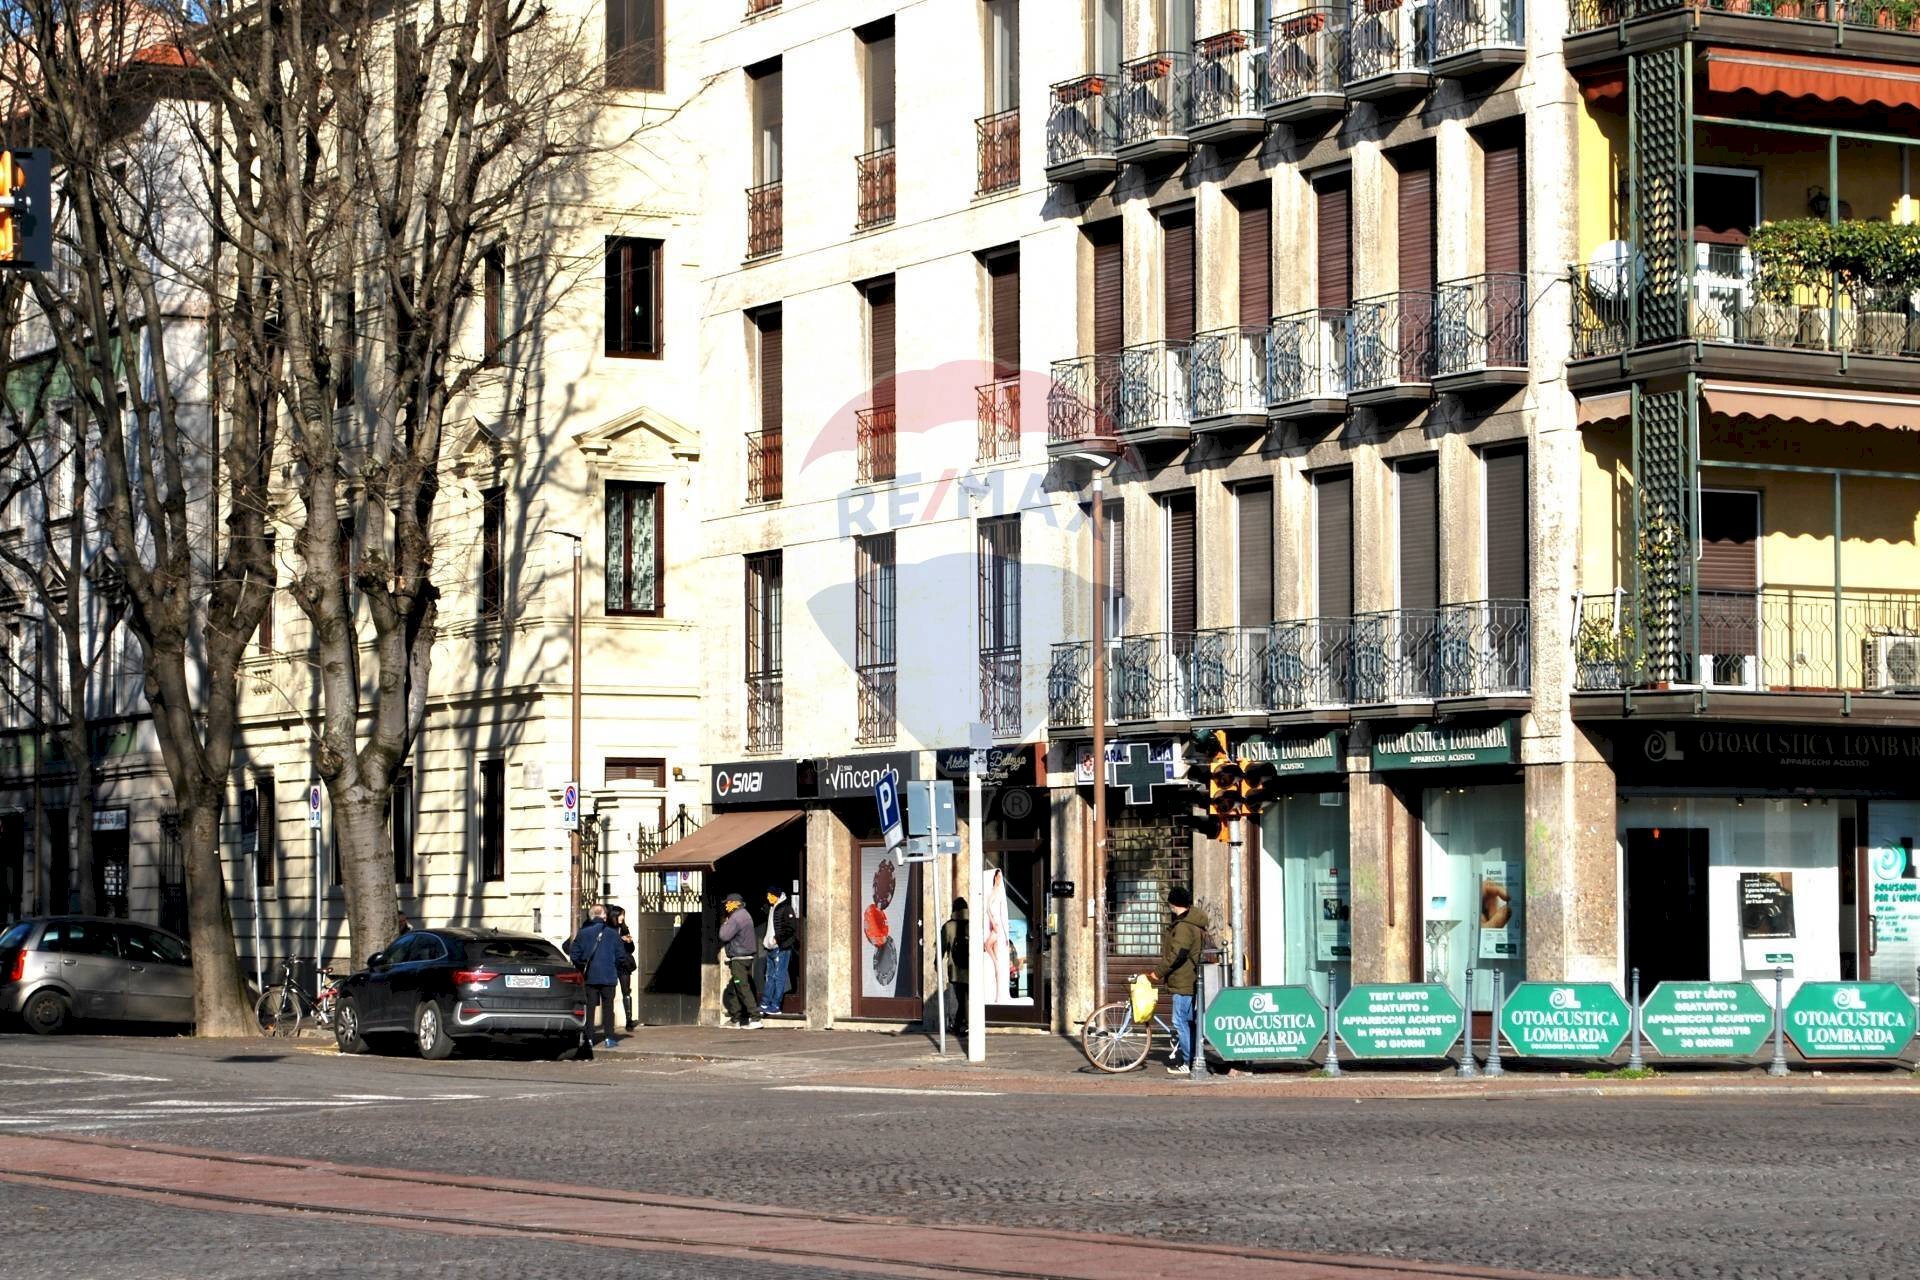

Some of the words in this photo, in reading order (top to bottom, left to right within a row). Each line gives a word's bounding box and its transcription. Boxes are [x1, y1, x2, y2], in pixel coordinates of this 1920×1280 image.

[1377, 731, 1446, 755] OTOACUSTICA
[1450, 727, 1508, 750] LOMBARDA
[1699, 731, 1833, 755] OTOACUSTICA
[1282, 737, 1333, 759] LOMBARDA
[1410, 754, 1445, 763] APPARECCHI
[1448, 753, 1475, 762] ACUSTICI
[879, 782, 892, 826] P
[1369, 992, 1395, 1000] TEST
[1397, 992, 1428, 1000] UDITO
[1674, 990, 1701, 999] TEST
[1369, 1004, 1420, 1012] GRATUITO
[1674, 1002, 1728, 1011] GRATUITO
[1214, 1014, 1316, 1030] OTOACUSTICA
[1343, 1016, 1406, 1025] APPARECCHI
[1408, 1015, 1456, 1024] ACUSTICI
[1511, 1011, 1619, 1026] OTOACUSTICA
[1648, 1015, 1713, 1024] APPARECCHI
[1715, 1014, 1765, 1023] ACUSTICI
[1794, 1011, 1905, 1026] OTOACUSTICA
[1369, 1028, 1403, 1036] PROVA
[1405, 1027, 1442, 1036] GRATIS
[1523, 1027, 1609, 1042] LOMBARDA
[1674, 1027, 1710, 1035] PROVA
[1711, 1026, 1750, 1035] GRATIS
[1807, 1028, 1895, 1043] LOMBARDA
[1226, 1030, 1306, 1046] LOMBARDA
[1695, 1039, 1733, 1047] GIORNI
[1375, 1040, 1387, 1048] 30
[1389, 1039, 1425, 1048] GIORNI
